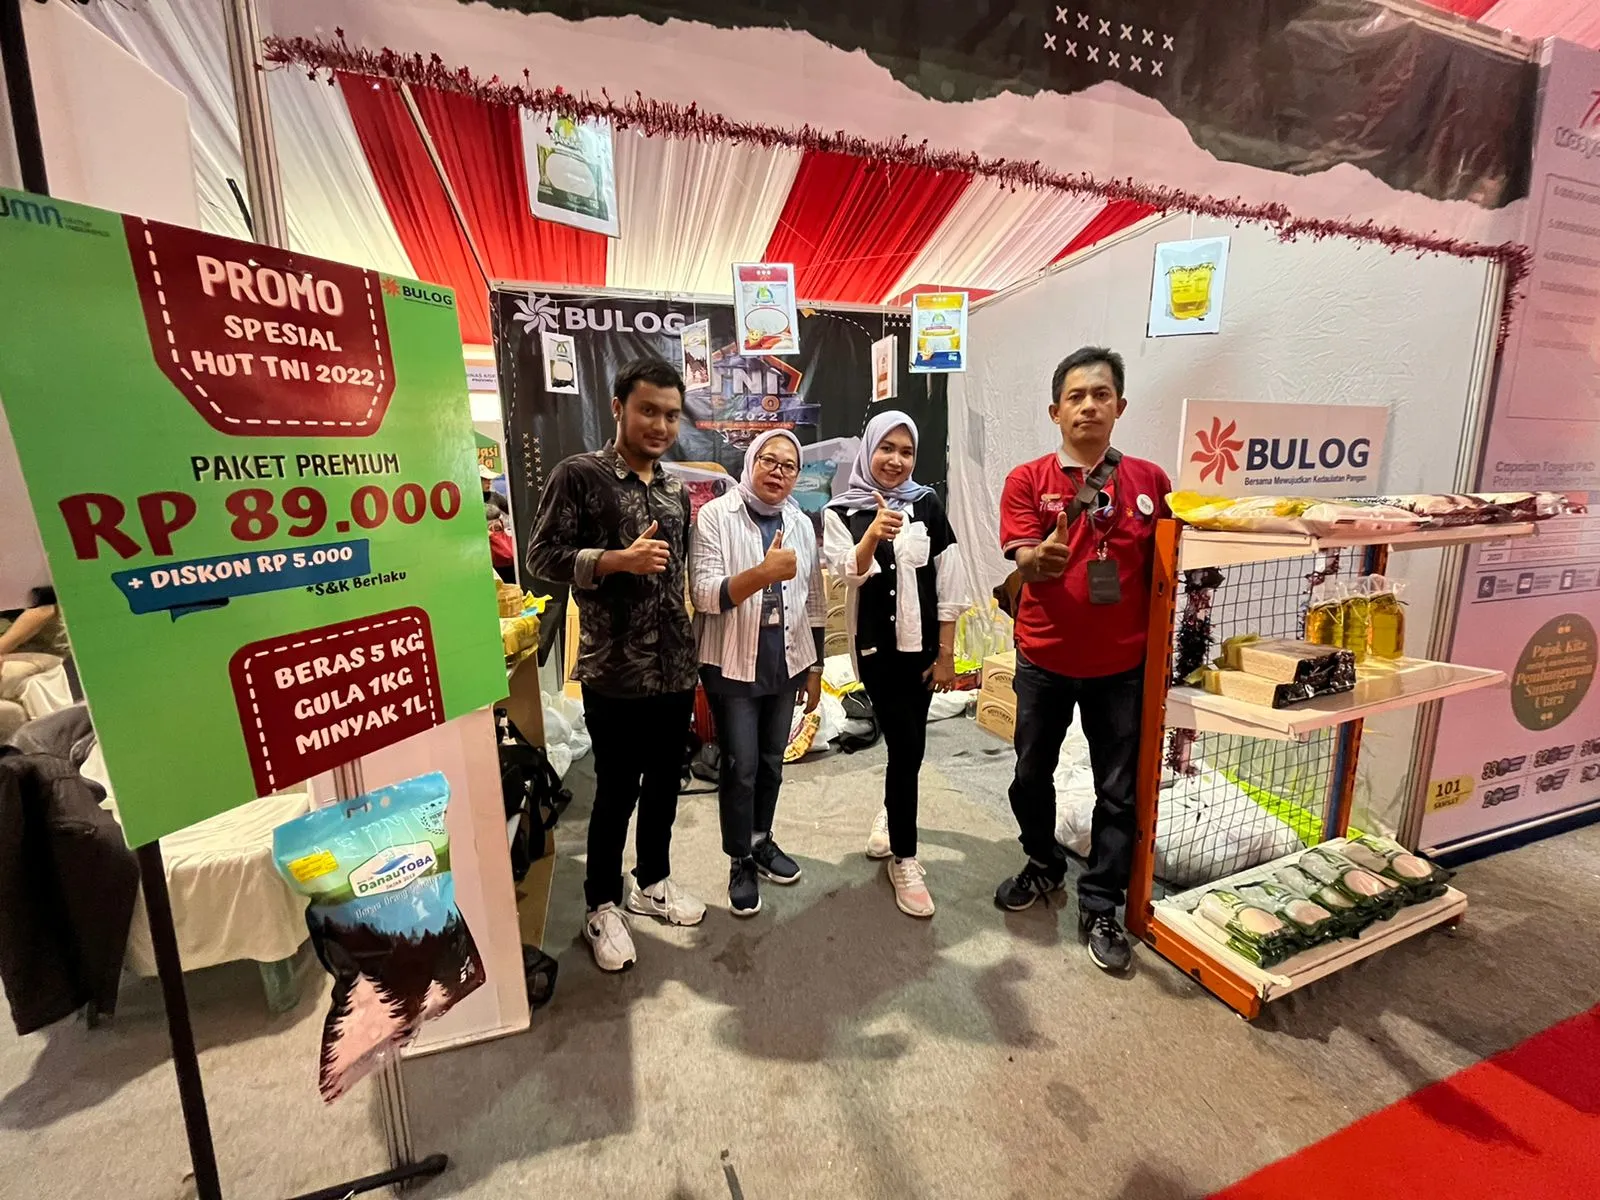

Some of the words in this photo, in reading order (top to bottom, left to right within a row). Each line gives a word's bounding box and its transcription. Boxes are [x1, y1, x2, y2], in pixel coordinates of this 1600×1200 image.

[196, 254, 344, 317] PROMO
[402, 286, 453, 305] BULOG
[224, 314, 342, 352] SPESIAL
[564, 306, 686, 335] BULOG
[191, 350, 254, 378] HUT
[261, 354, 311, 382] TNI
[315, 364, 375, 387] 2022
[735, 412, 778, 421] 2022
[191, 454, 286, 481] PAKET
[298, 452, 400, 476] PREMIUM
[1246, 438, 1370, 471] BULOG
[1244, 477, 1272, 486] Bersama
[1274, 475, 1311, 485] Mewujudkan
[58, 491, 197, 560] RP
[225, 480, 461, 541] 89.000
[128, 577, 144, 590] +
[150, 558, 252, 590] DISKON
[257, 551, 287, 573] RP
[293, 547, 353, 569] 5.000
[352, 570, 407, 590] Berlaku
[274, 651, 366, 689] BERAS
[370, 645, 385, 663] 5
[390, 633, 424, 656] KG
[294, 683, 365, 721] GULA
[367, 667, 414, 694] 1KG
[295, 704, 398, 755] MINYAK
[401, 695, 427, 716] 1L
[1435, 779, 1461, 798] 101
[358, 855, 433, 894] DanauTOBA
